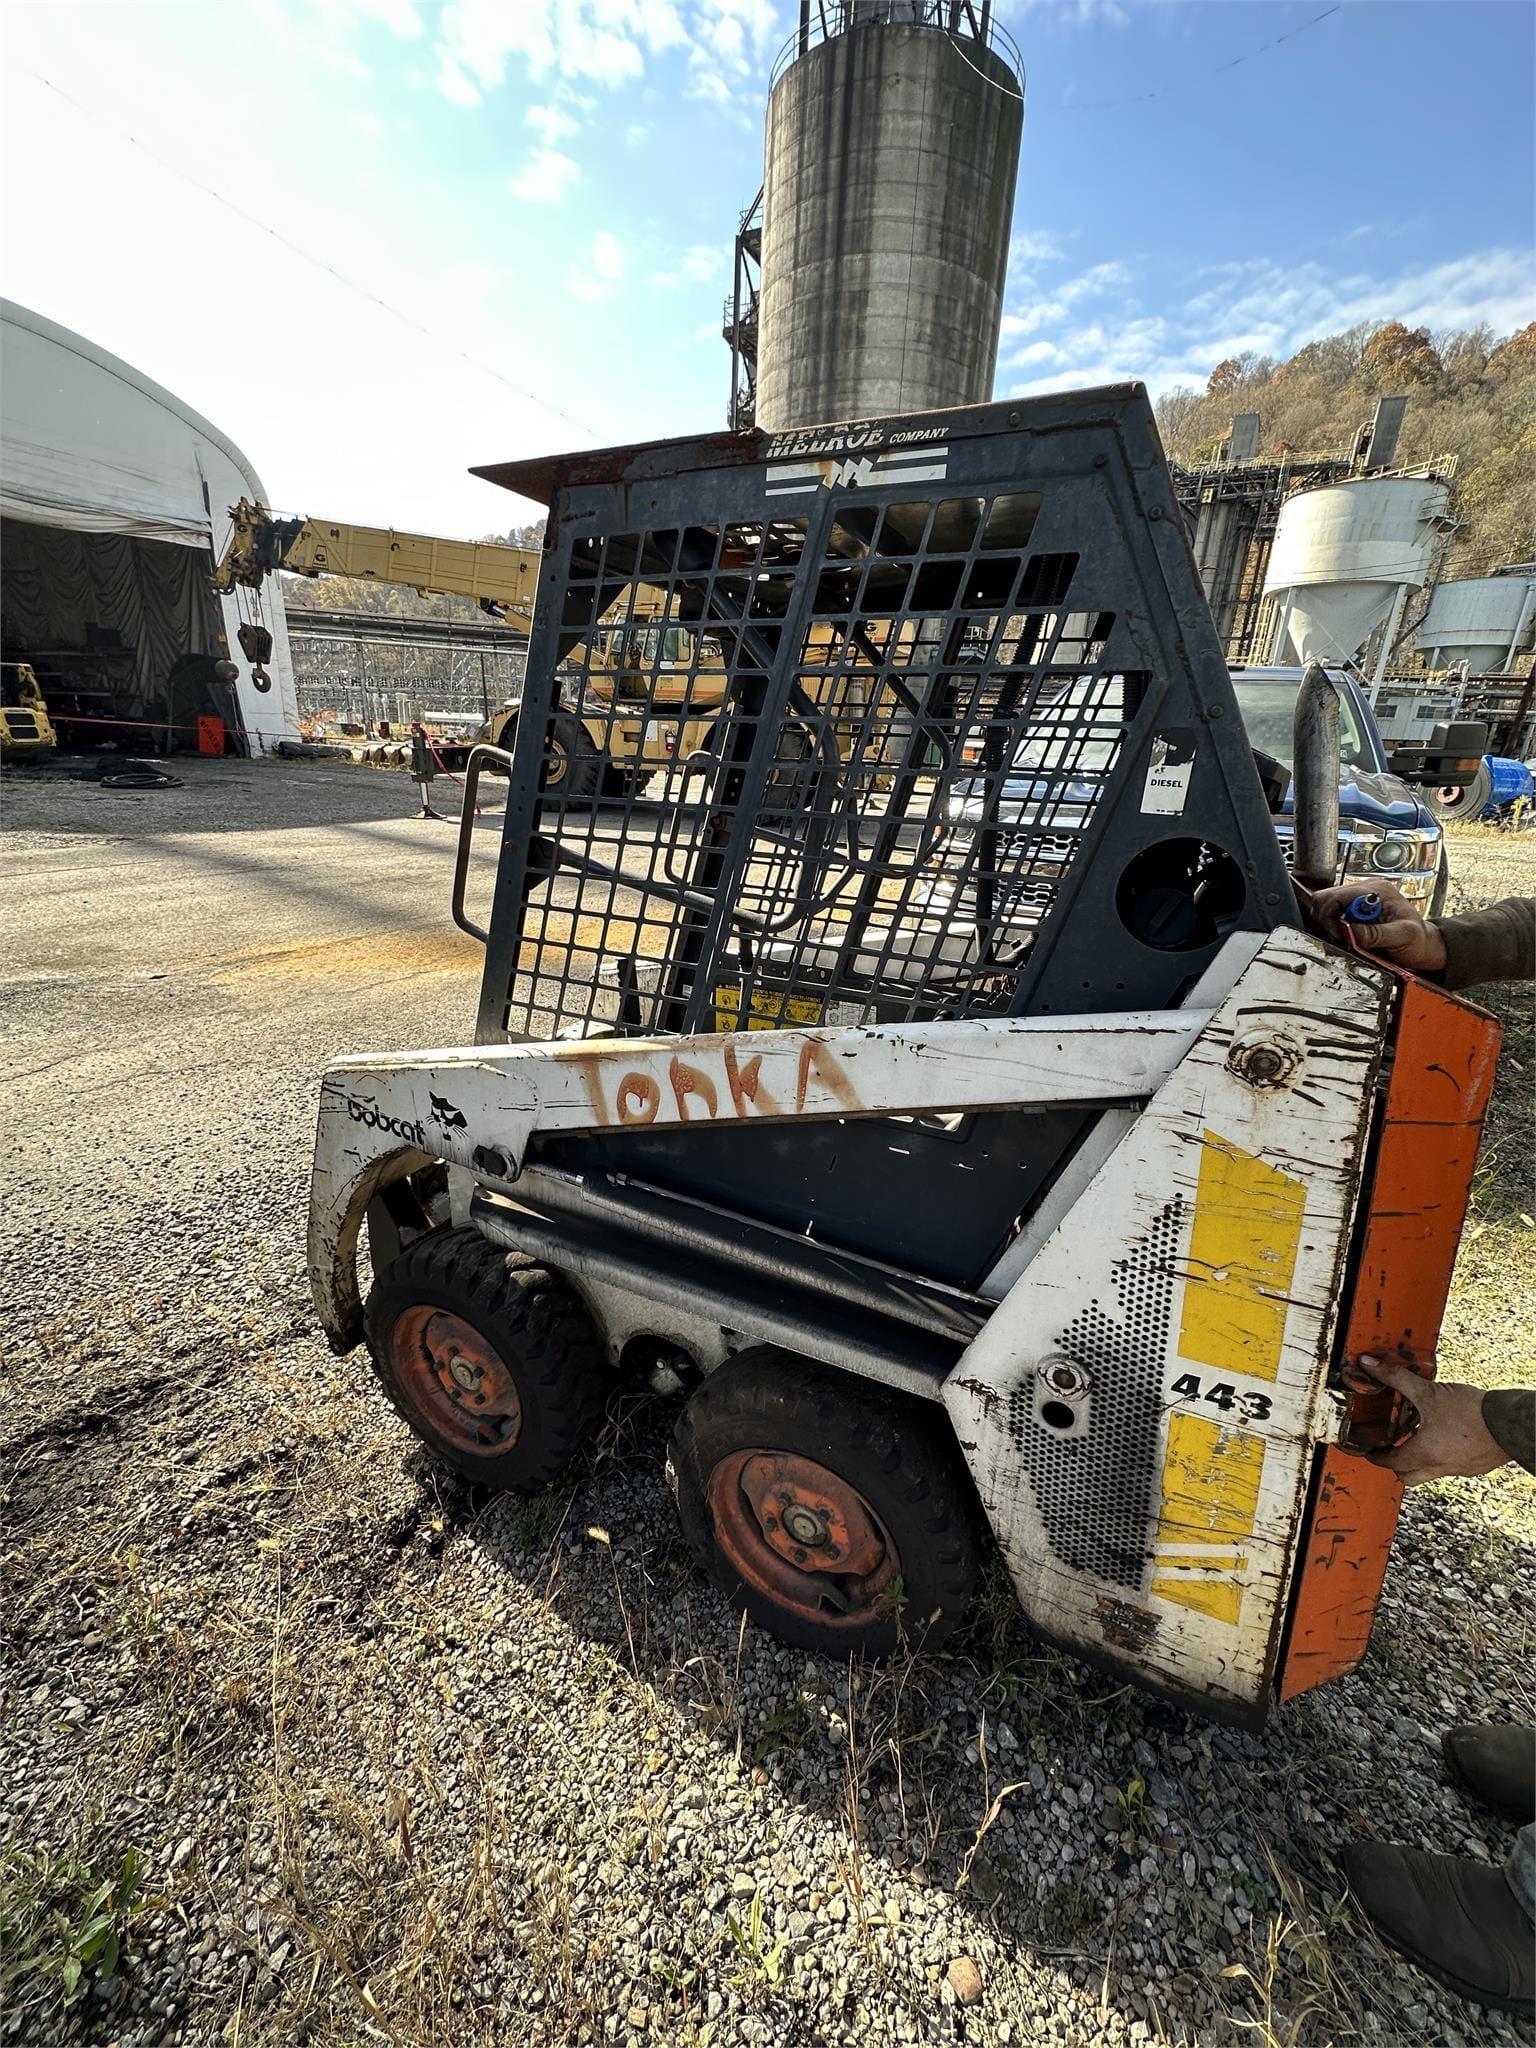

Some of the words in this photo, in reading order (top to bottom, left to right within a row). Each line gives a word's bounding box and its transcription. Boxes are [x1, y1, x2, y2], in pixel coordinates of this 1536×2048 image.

[889, 427, 950, 445] COMPANY
[1150, 779, 1184, 788] DIESEL
[1171, 1373, 1273, 1420] 443
